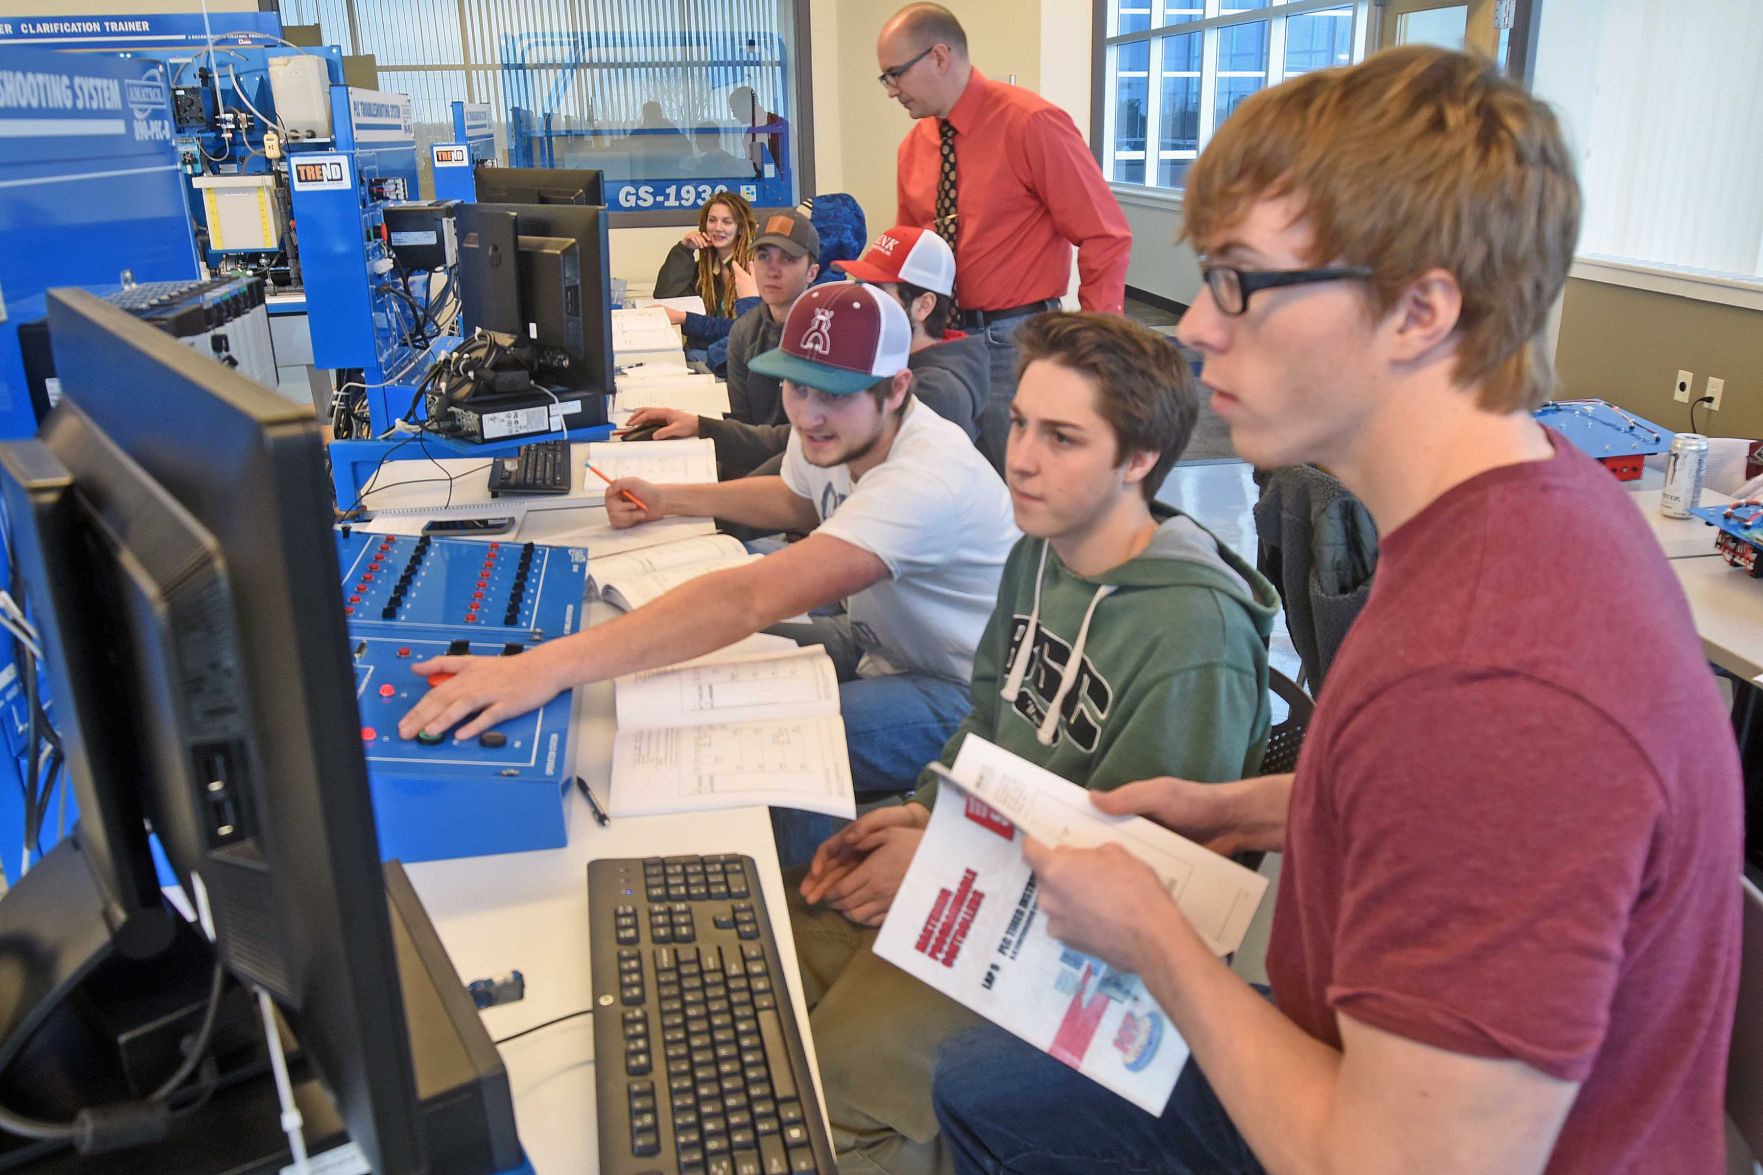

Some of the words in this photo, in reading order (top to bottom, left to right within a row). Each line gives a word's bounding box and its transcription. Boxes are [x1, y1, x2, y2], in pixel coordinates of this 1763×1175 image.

[20, 21, 101, 35] CLARIFICATION
[104, 20, 150, 32] TRAINER
[73, 75, 122, 110] SYSTEM
[296, 162, 343, 182] TREND
[915, 887, 952, 953] MASTERING
[928, 867, 978, 961] PROGRAMMABLE
[941, 889, 985, 968] CONTROLLERS
